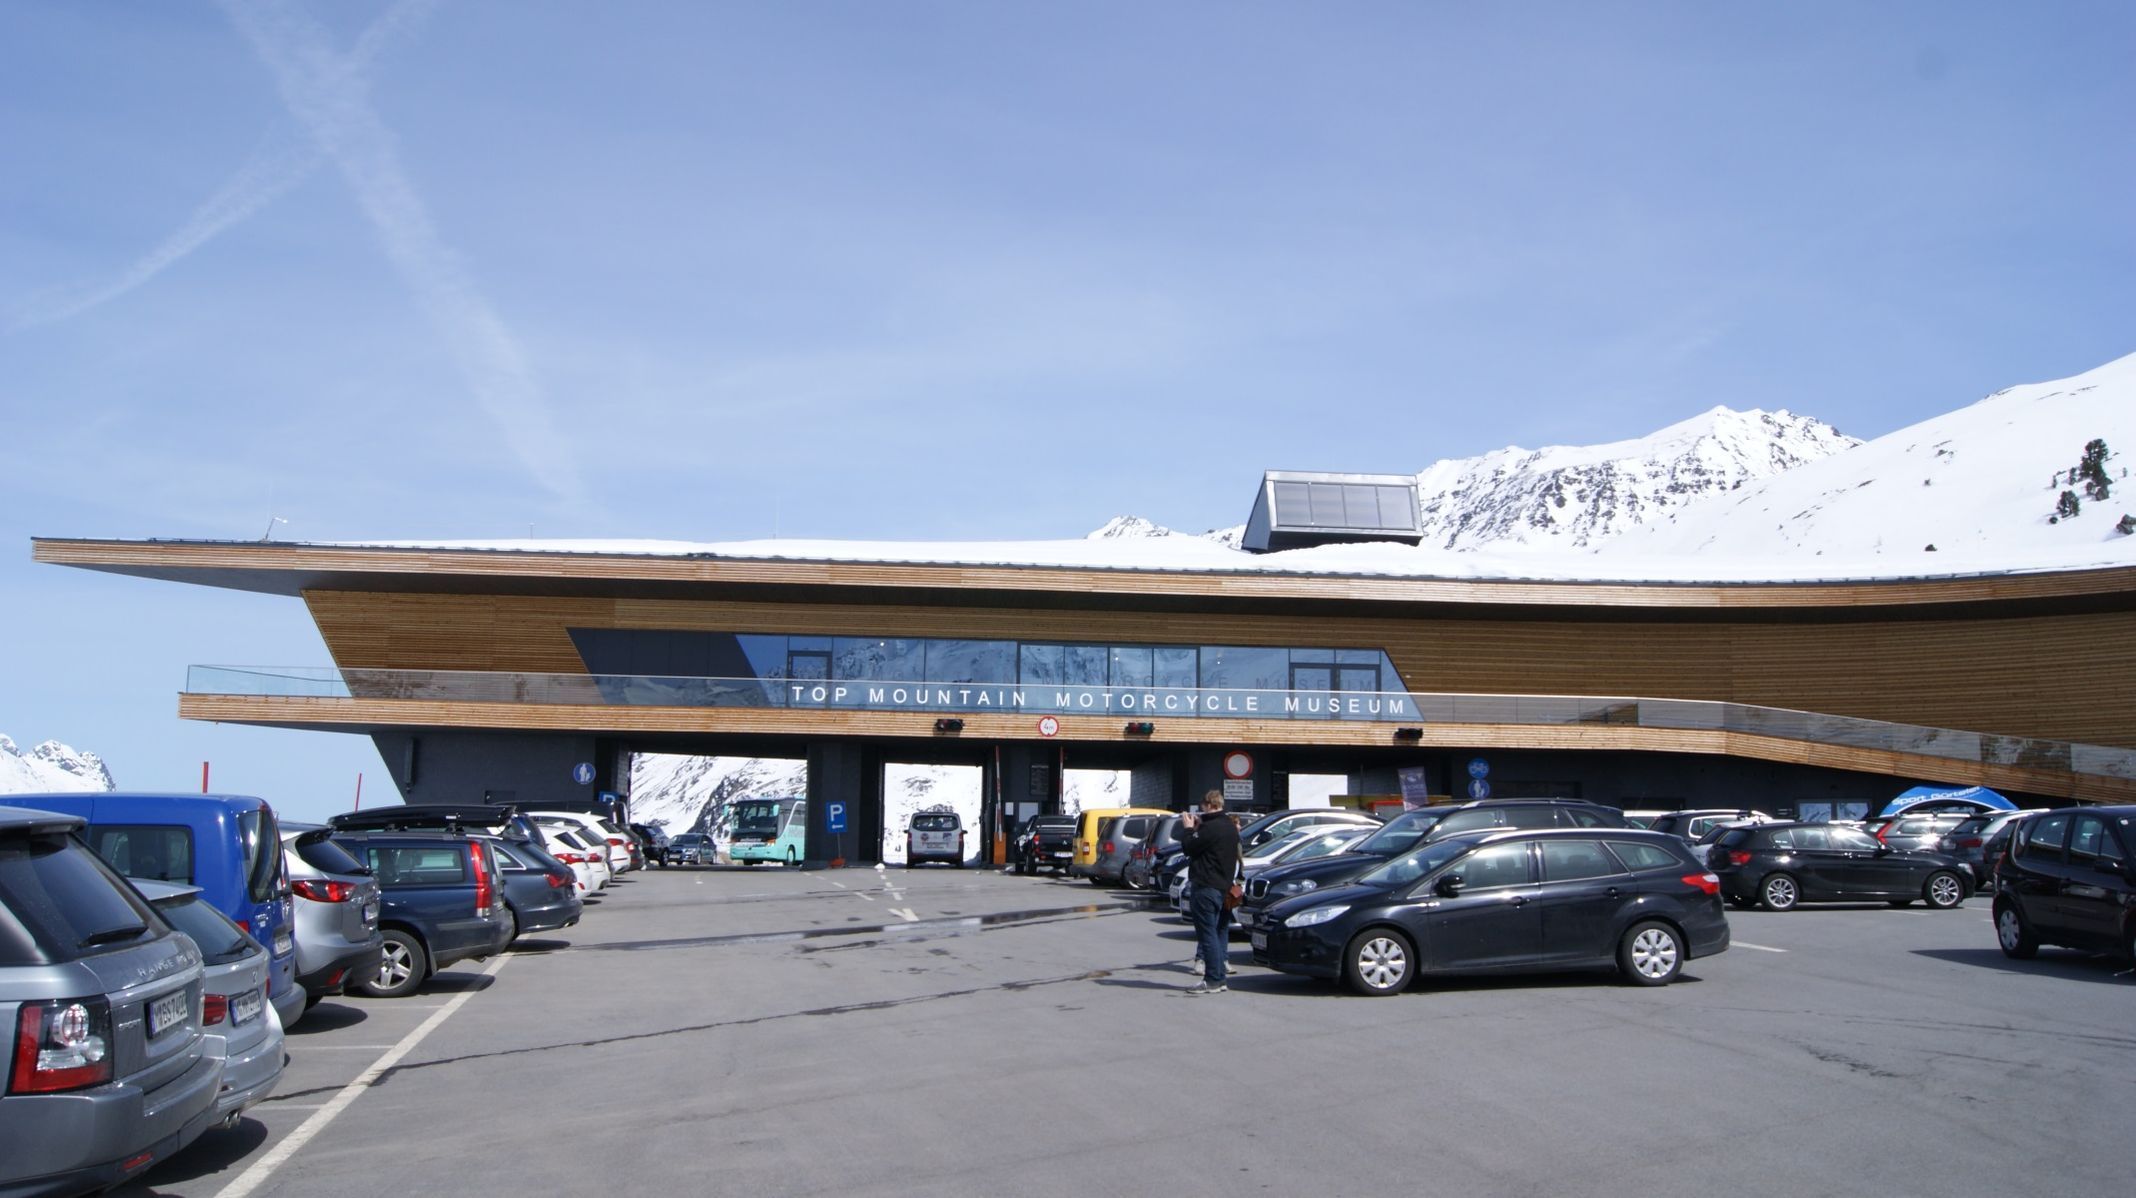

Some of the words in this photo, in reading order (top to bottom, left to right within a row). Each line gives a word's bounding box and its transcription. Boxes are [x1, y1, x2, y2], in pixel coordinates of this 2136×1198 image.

[791, 685, 848, 702] TOP
[868, 687, 1026, 706] MOUNTAIN
[1055, 692, 1259, 711] MOTORCYCLE
[1284, 696, 1405, 715] MUSEUM
[829, 803, 843, 822] P
